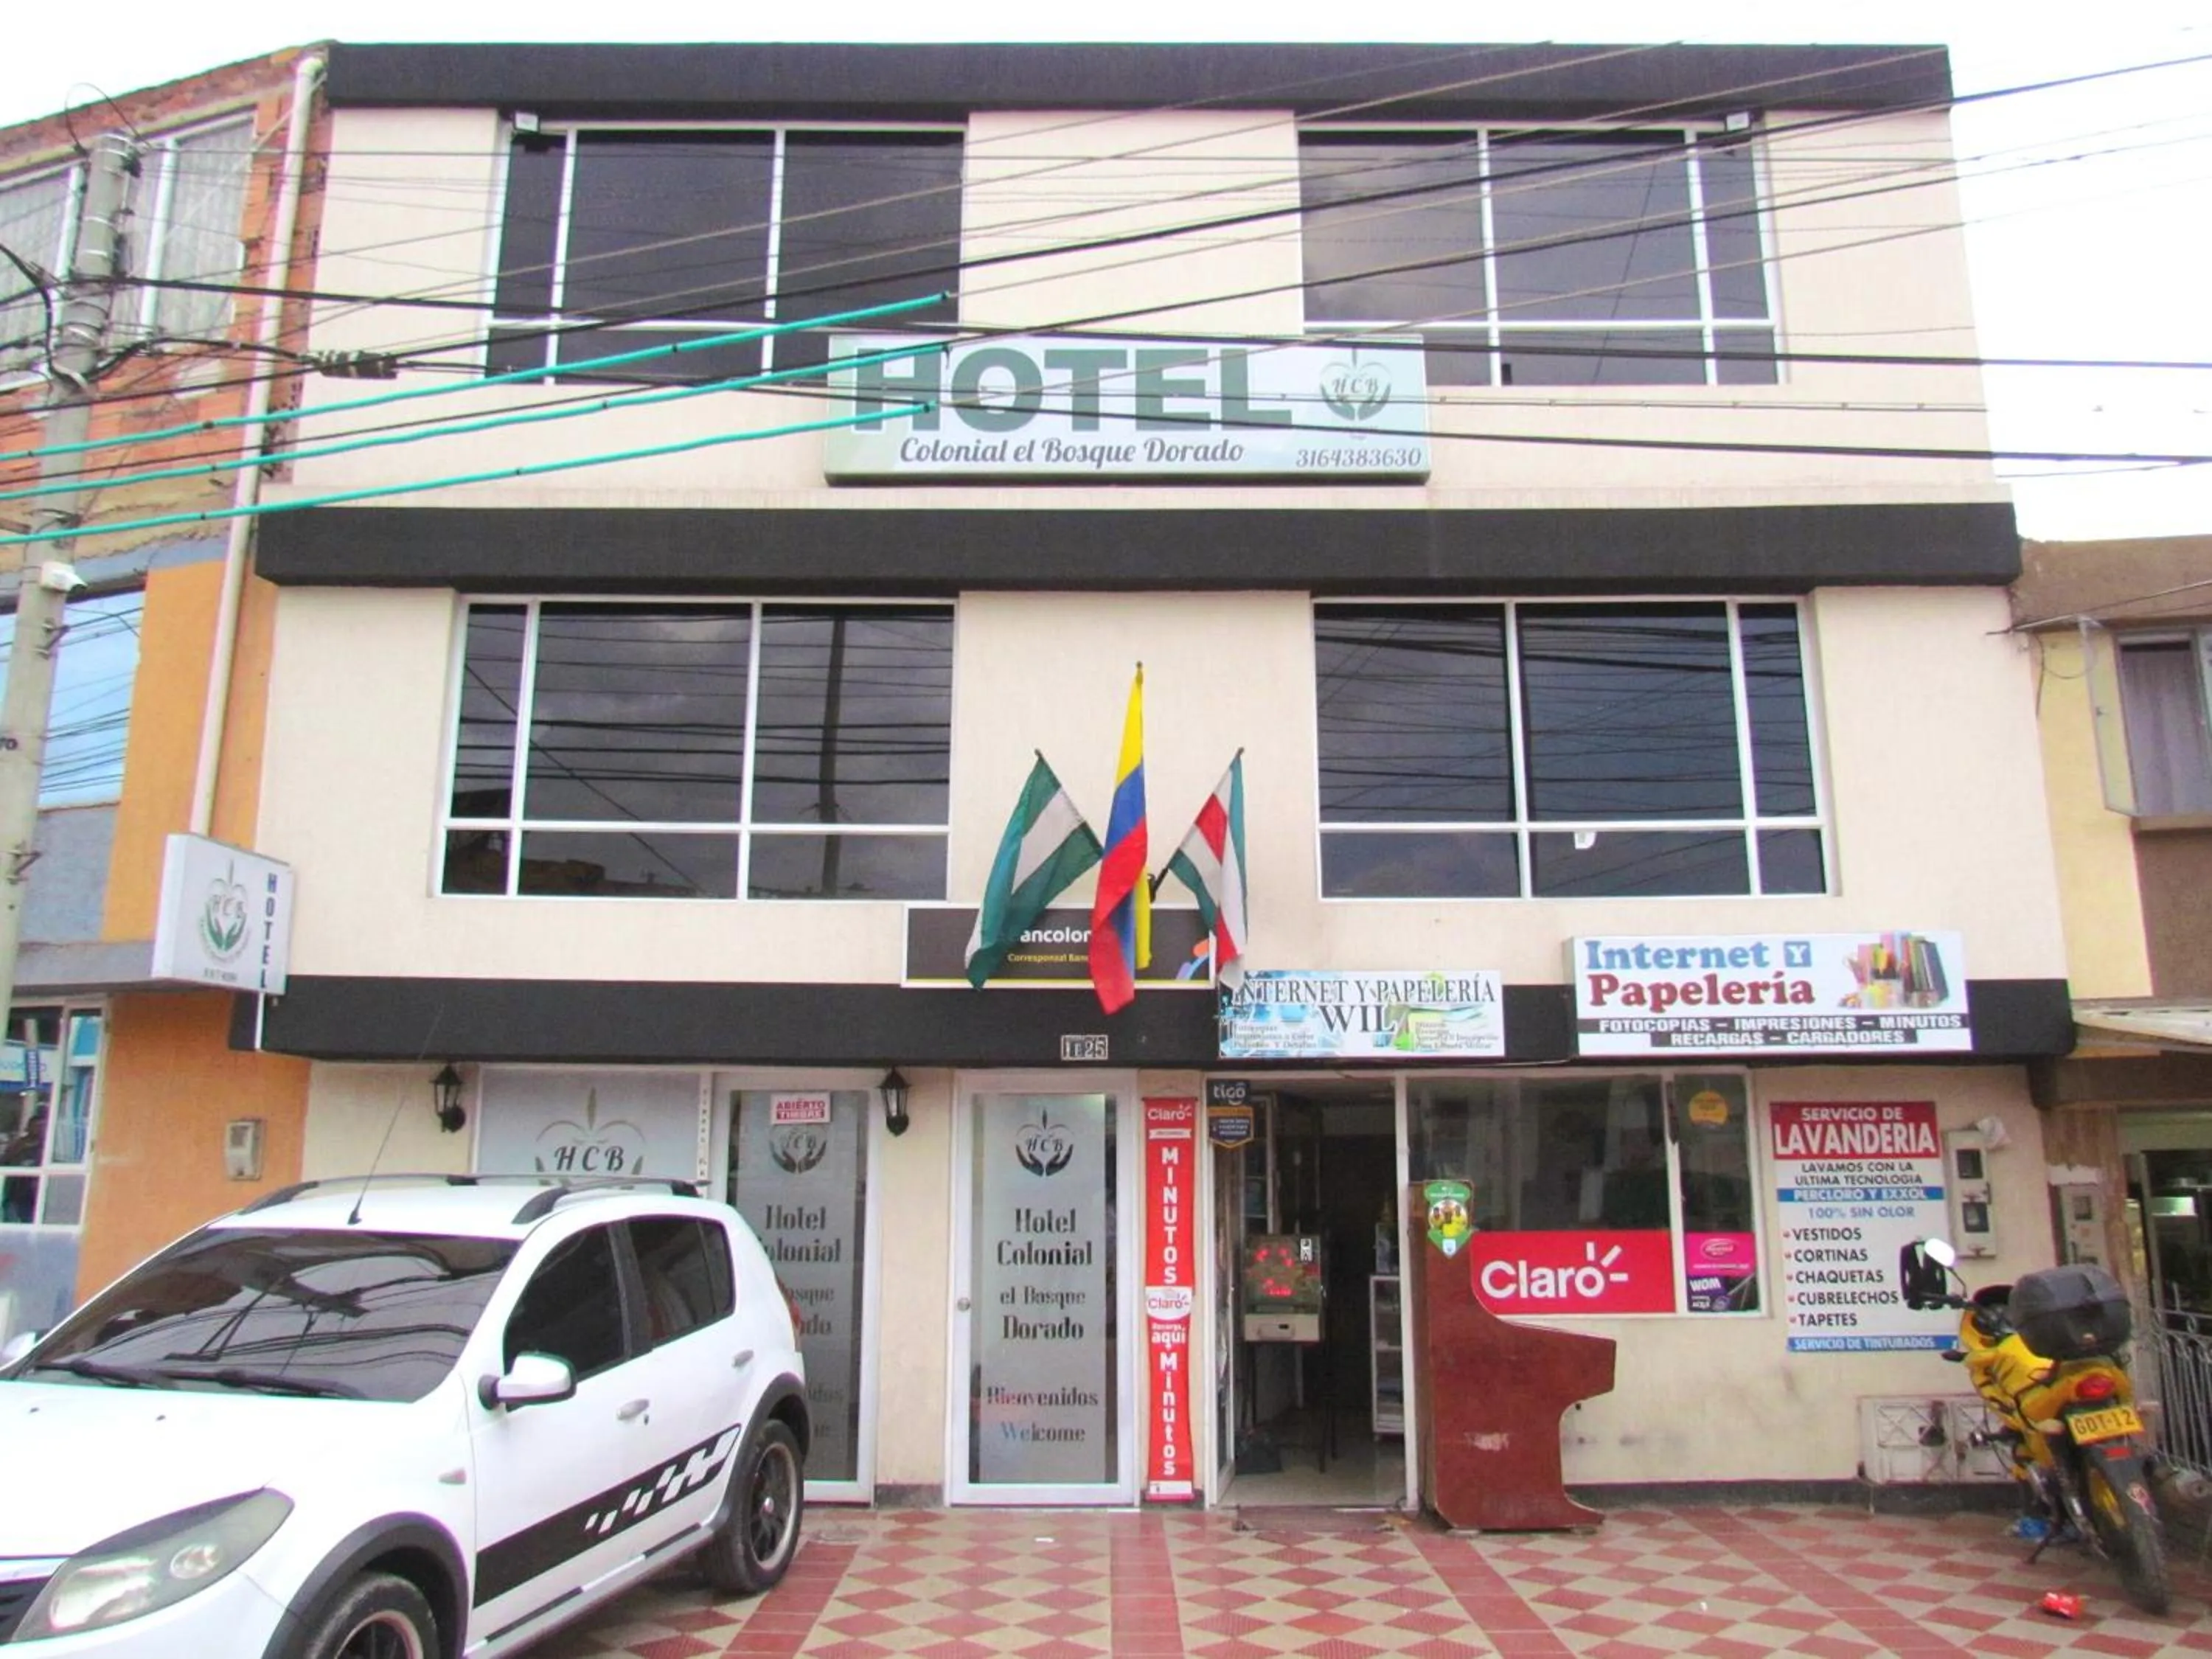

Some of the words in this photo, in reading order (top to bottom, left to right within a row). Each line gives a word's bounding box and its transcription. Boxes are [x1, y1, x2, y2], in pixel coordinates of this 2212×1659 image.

[854, 347, 1293, 432] HOTEL
[900, 437, 1006, 463] Colonial
[1012, 438, 1034, 463] el
[1040, 437, 1136, 470] Bosque
[1143, 437, 1245, 463] Dorado
[1295, 447, 1422, 468] 3164383630
[261, 872, 278, 989] HOTEL
[1583, 939, 1770, 970] Internet
[1787, 943, 1809, 967] Y
[1354, 980, 1371, 1002] Y
[1373, 973, 1497, 1003] PAPELERÍA
[1587, 971, 1815, 1014] Papelería
[1317, 1004, 1396, 1033] WIL
[1599, 1018, 1711, 1033] FOTOCOPIAS
[1734, 1017, 1857, 1032] IMPRESIONES
[1879, 1015, 1961, 1029] MINUTOS
[1670, 1032, 1764, 1046] RECARGAS
[1787, 1029, 1905, 1045] CARGADORES
[1213, 1085, 1246, 1105] tigo
[1147, 1107, 1186, 1121] Claro
[1801, 1107, 1877, 1121] SERVICIO
[1882, 1107, 1904, 1120] DE
[1774, 1122, 1936, 1155] LAVANDERIA
[553, 1145, 625, 1172] HCB
[1801, 1161, 1863, 1173] LAVAMOS
[1867, 1161, 1896, 1172] CON
[1899, 1161, 1913, 1172] LA
[1795, 1175, 1840, 1186] ULTIMA
[1843, 1174, 1923, 1186] TECNOLOGIA
[1793, 1189, 1861, 1201] PERCLORO
[765, 1204, 827, 1231] Hotel
[1015, 1207, 1077, 1234] Hotel
[1161, 1147, 1179, 1284] MINUTOS
[1850, 1206, 1873, 1217] SIN
[1877, 1206, 1916, 1217] OLOR
[1792, 1227, 1862, 1242] VESTIDOS
[763, 1237, 842, 1265] olonial
[997, 1239, 1093, 1266] Colonial
[1794, 1248, 1868, 1263] CORTINAS
[1481, 1259, 1606, 1298] Claro
[1689, 1277, 1722, 1292] WOM
[1795, 1270, 1884, 1284] CHAQUETAS
[1000, 1286, 1015, 1305] el
[1023, 1284, 1086, 1310] Bosque
[1147, 1296, 1183, 1310] Claro
[1797, 1290, 1899, 1306] CUBRELECHOS
[1003, 1315, 1085, 1340] Dorado
[1798, 1312, 1858, 1326] TAPETES
[1151, 1327, 1186, 1351] aquí
[1794, 1338, 1844, 1350] SERVICIO
[1846, 1338, 1861, 1349] DE
[987, 1385, 1099, 1407] Bienvenidos
[1159, 1352, 1178, 1476] Minutos
[1000, 1421, 1086, 1442] Welcome
